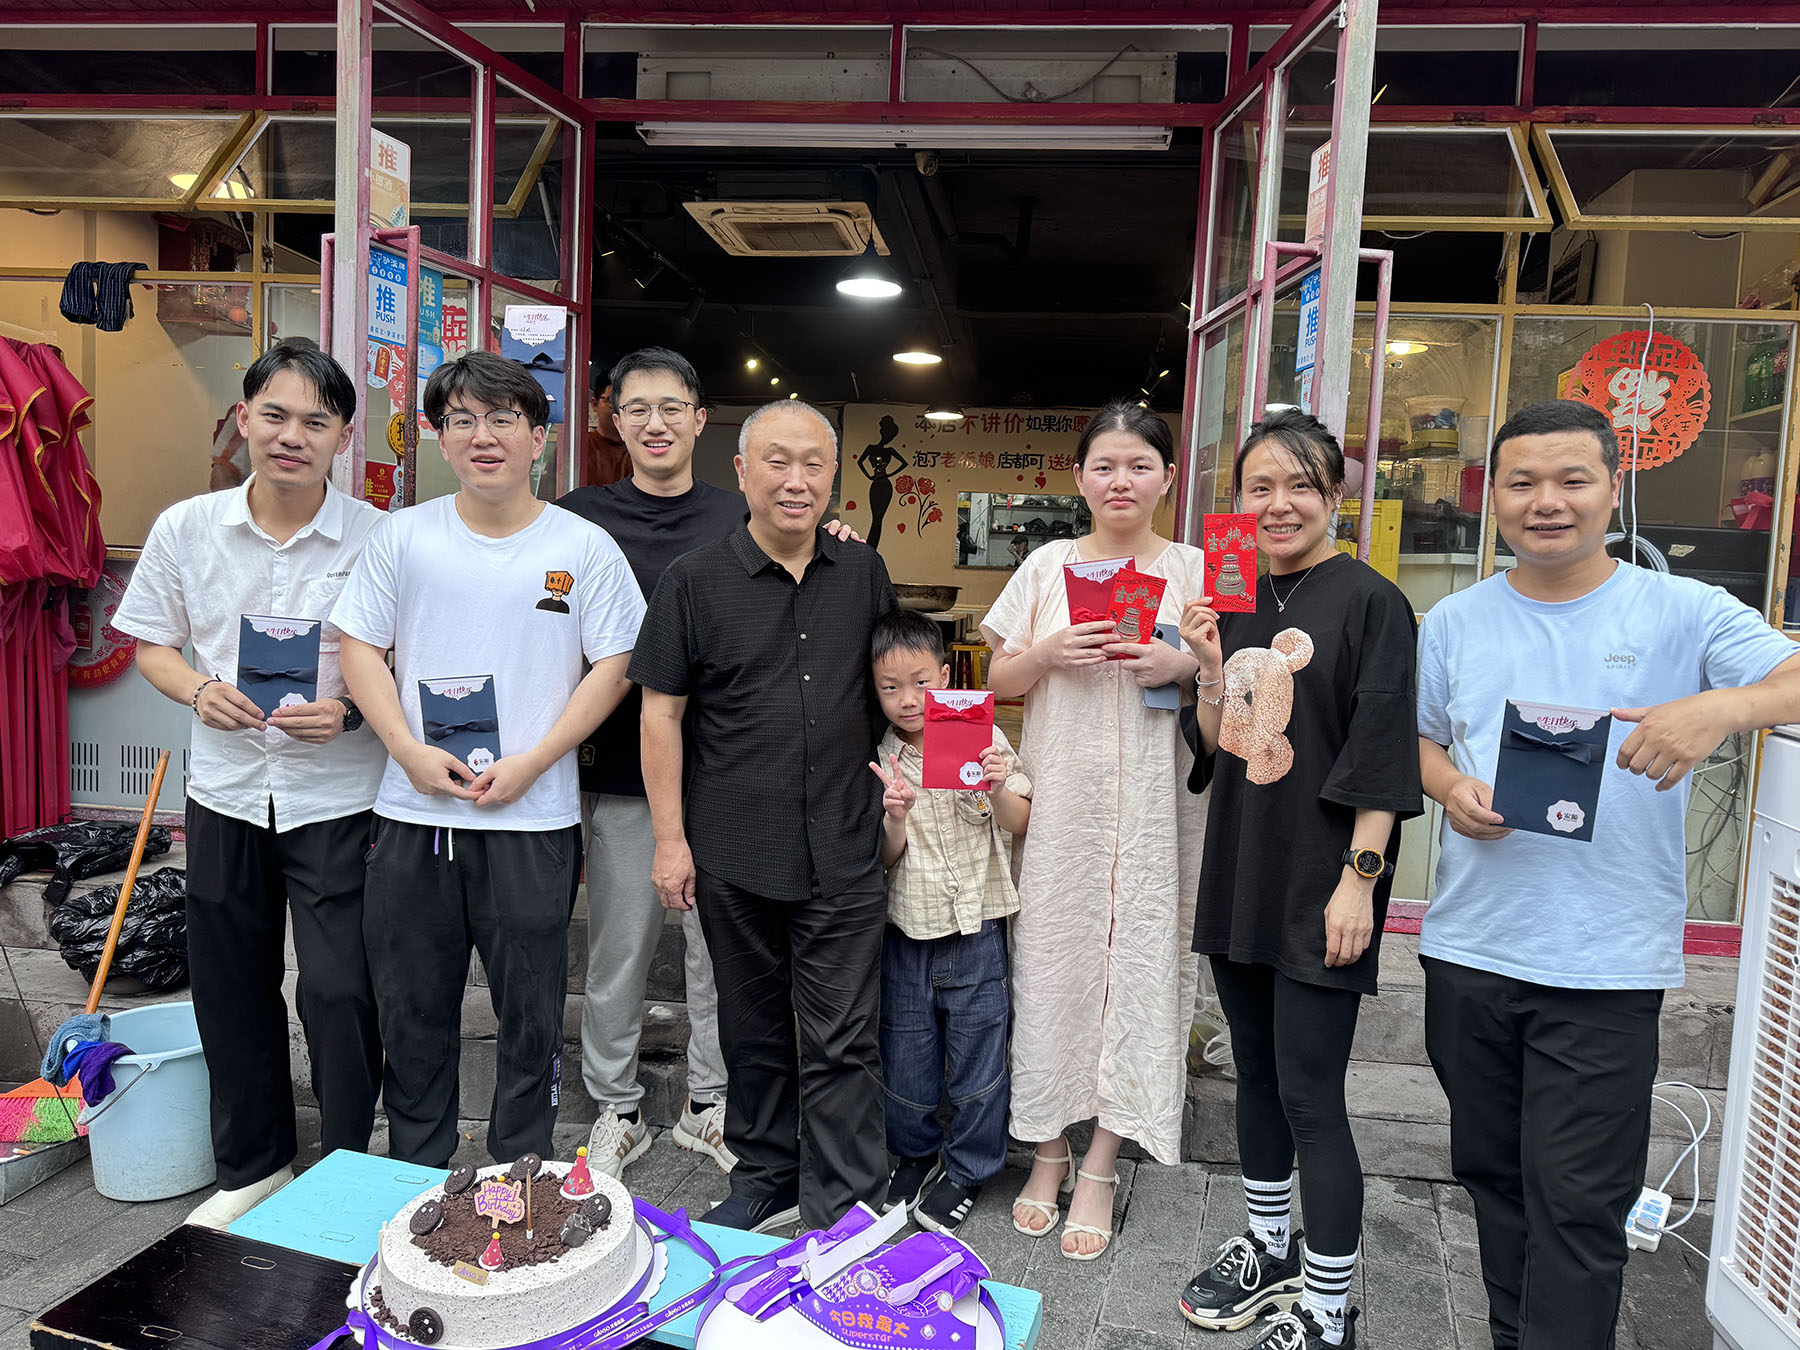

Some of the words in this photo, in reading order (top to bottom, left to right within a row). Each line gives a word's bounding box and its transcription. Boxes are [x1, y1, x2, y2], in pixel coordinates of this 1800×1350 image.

[378, 140, 397, 171] 推
[376, 283, 396, 313] 推
[376, 311, 396, 324] PUSH
[1603, 653, 1636, 665] Jeep
[484, 1184, 513, 1201] Happy
[477, 1194, 521, 1221] Birthday
[829, 1309, 911, 1339] 今日我最大
